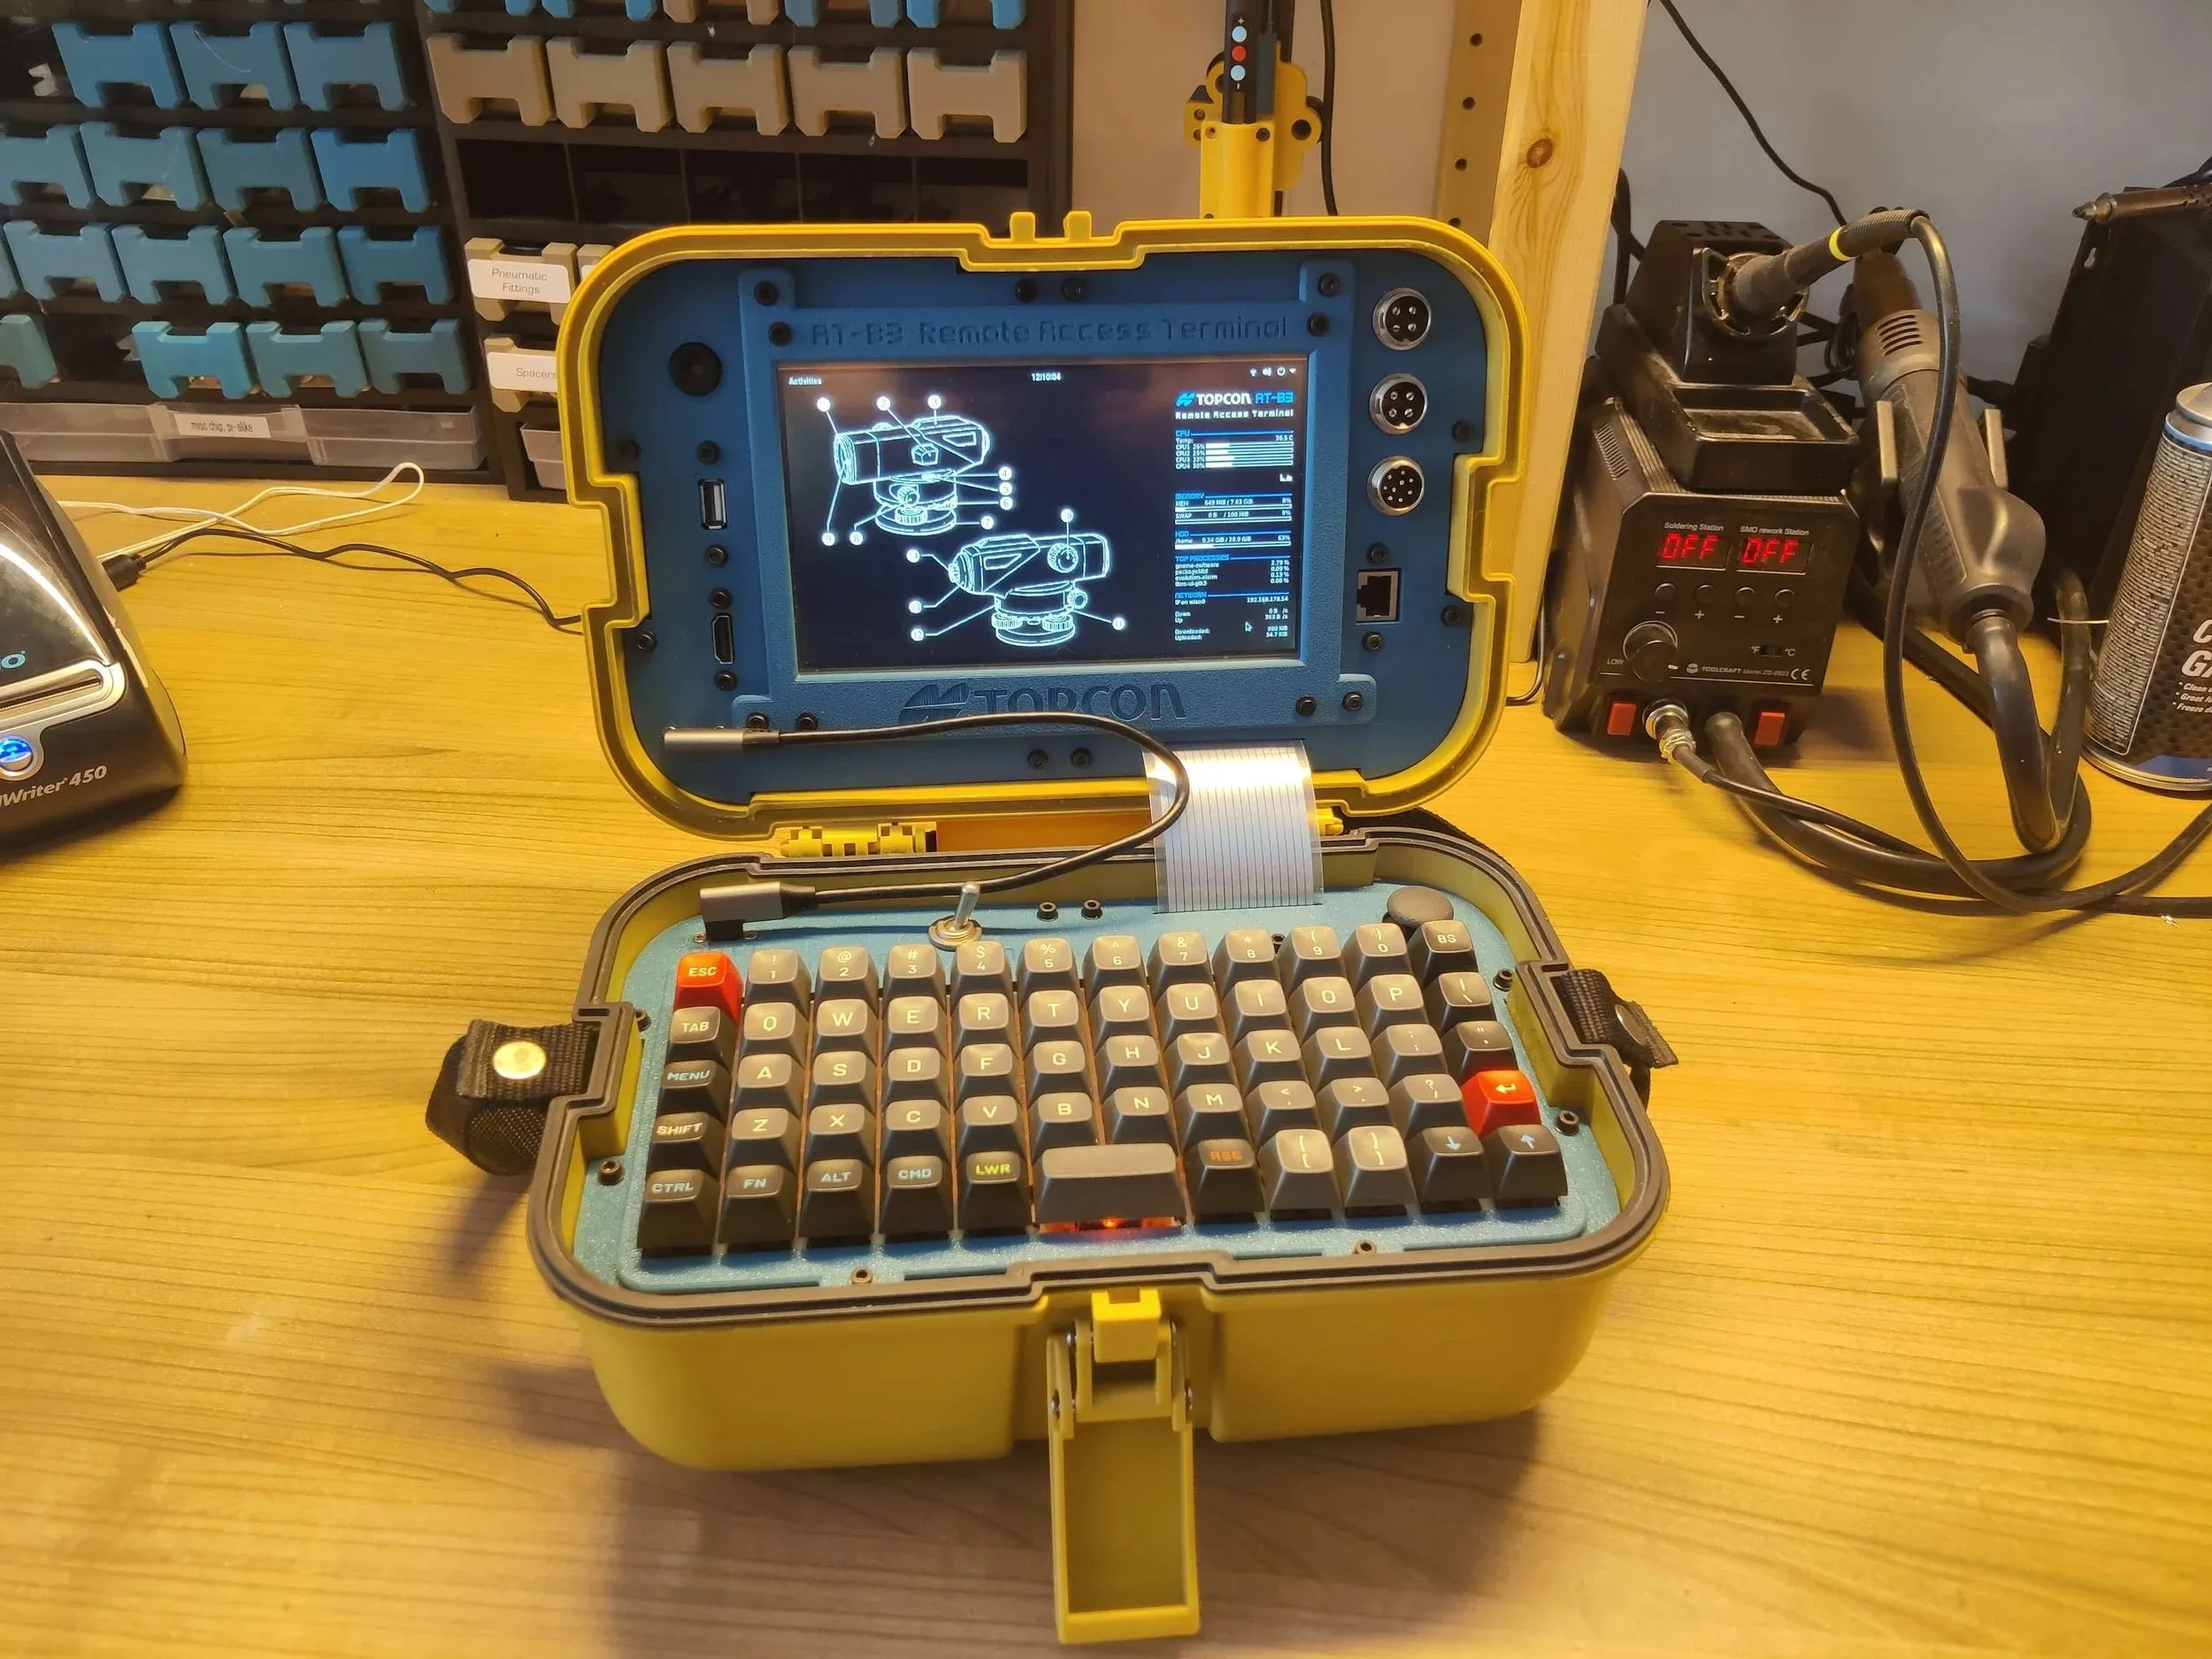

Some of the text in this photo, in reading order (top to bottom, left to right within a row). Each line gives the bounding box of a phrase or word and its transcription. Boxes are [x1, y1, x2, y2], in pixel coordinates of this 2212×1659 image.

[492, 268, 547, 281] Pneumatic
[503, 282, 541, 296] Fittings
[811, 316, 1287, 346] AT-B3 Remote Access Terminal
[516, 367, 557, 379] Spacers
[788, 375, 822, 386] Activities
[1196, 391, 1294, 406] TOPCON AT-B3
[1175, 409, 1294, 420] Remote Access Terminal
[191, 421, 208, 431] misc
[1663, 521, 1724, 532] Soldering Station
[1759, 526, 1783, 535] rework
[1662, 533, 1718, 560] OFF
[1742, 537, 1799, 565] OFF
[2183, 682, 2207, 693] Clean
[2180, 692, 2205, 703] Great
[2176, 703, 2205, 713] Freeze
[69, 764, 107, 787] 450
[1437, 933, 1457, 944] BS
[1179, 951, 1188, 962] 7
[1246, 949, 1256, 959] 8
[1312, 946, 1323, 956] 9
[977, 961, 987, 971] 4
[1044, 958, 1054, 969] 5
[1112, 956, 1123, 966] 6
[688, 966, 718, 978] ESC
[839, 966, 849, 977] 2
[907, 964, 918, 974] 3
[1321, 989, 1336, 1004] O
[1388, 987, 1403, 1002] P
[1118, 998, 1131, 1013] Y
[1185, 996, 1199, 1010] U
[977, 1006, 991, 1021] R
[1047, 1002, 1060, 1018] T
[832, 1011, 854, 1027] W
[906, 1010, 920, 1025] E
[681, 1021, 710, 1033] TAB
[763, 1016, 778, 1033] Q
[1265, 1041, 1282, 1055] K
[1335, 1038, 1352, 1051] L
[1052, 1052, 1067, 1066] G
[1125, 1046, 1141, 1059] H
[1197, 1046, 1210, 1060] J
[833, 1063, 848, 1077] S
[907, 1059, 921, 1073] D
[979, 1056, 994, 1071] F
[666, 1069, 710, 1081] MENU
[757, 1065, 772, 1079] A
[1133, 1096, 1150, 1110] N
[1205, 1094, 1224, 1106] M
[982, 1105, 997, 1118] V
[1057, 1102, 1072, 1116] B
[829, 1114, 845, 1128] X
[906, 1110, 921, 1124] C
[656, 1122, 703, 1136] SHIFT
[752, 1118, 769, 1133] Z
[897, 1168, 932, 1180] CMD
[975, 1164, 1010, 1176] LWR
[742, 1178, 767, 1189] FN
[820, 1171, 852, 1183] ALT
[650, 1181, 695, 1194] CTRL
